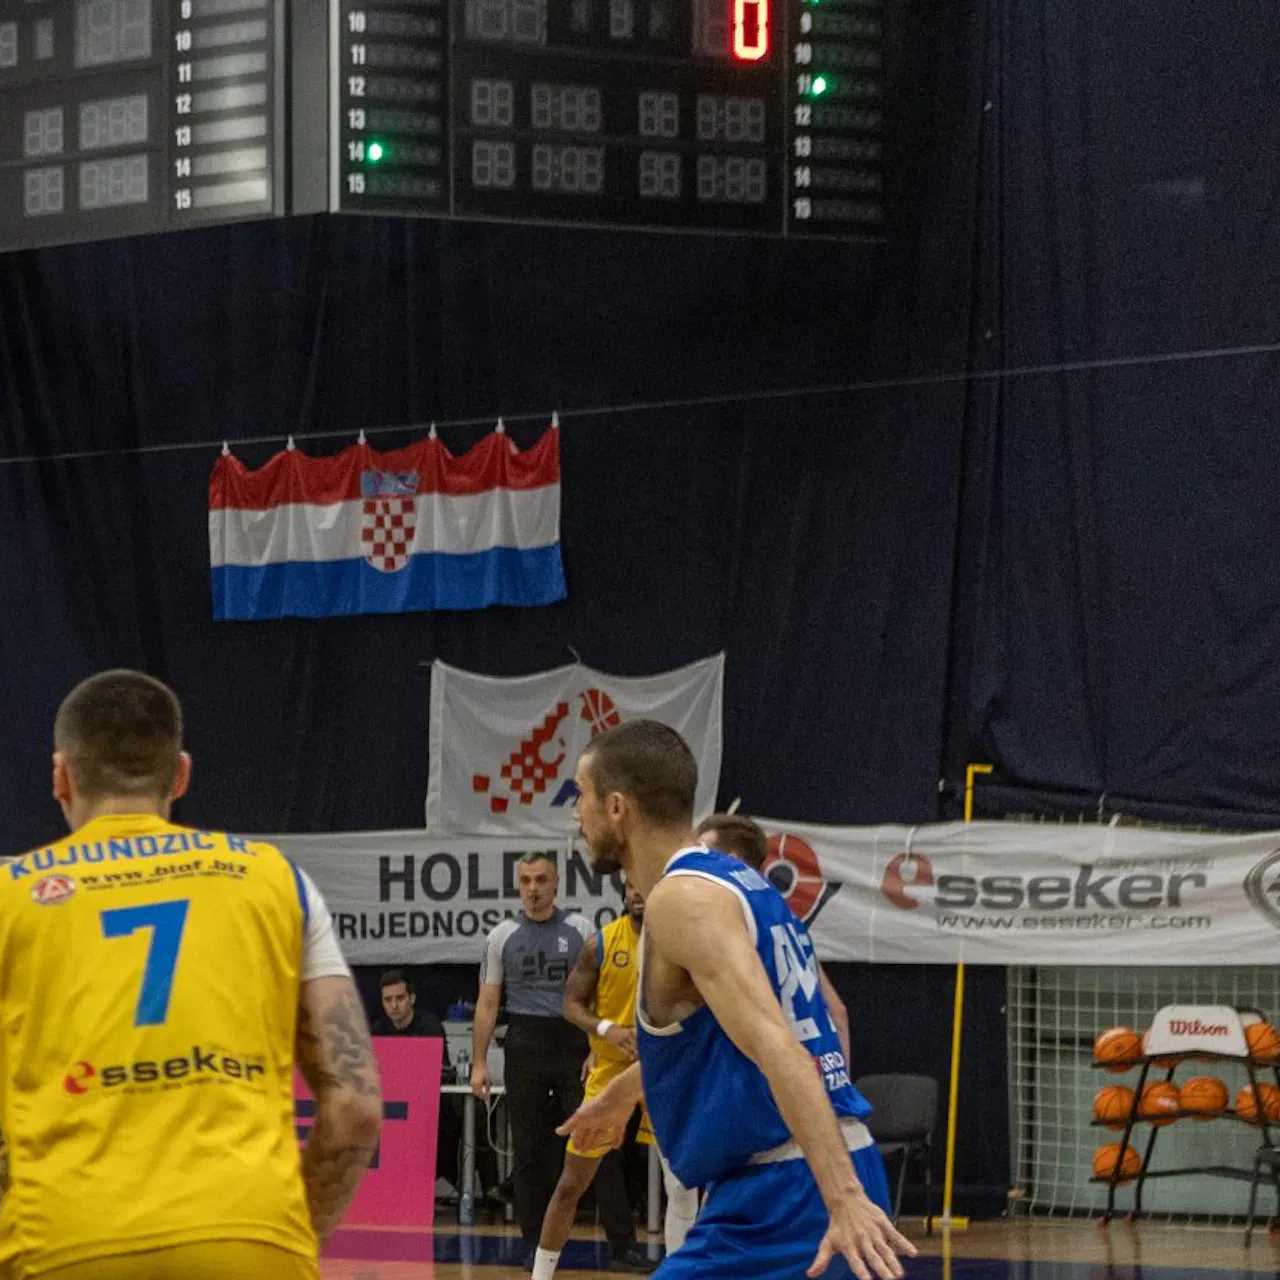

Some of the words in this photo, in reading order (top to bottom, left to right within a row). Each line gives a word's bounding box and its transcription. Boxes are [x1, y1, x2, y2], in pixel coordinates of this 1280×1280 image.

[348, 11, 366, 33] 10
[175, 30, 191, 51] 10
[350, 44, 366, 65] 11
[178, 62, 191, 83] 11
[348, 76, 365, 97] 12
[176, 93, 191, 114] 12
[348, 108, 366, 130] 13
[795, 104, 812, 126] 12
[175, 125, 191, 146] 13
[348, 141, 365, 162] 14
[175, 157, 191, 178] 14
[348, 173, 365, 194] 15
[175, 189, 191, 210] 15
[882, 852, 1207, 910] esseker
[937, 914, 1212, 931] www.esseker.com
[99, 898, 192, 1028] 7
[1169, 1020, 1229, 1036] Wilson
[64, 1046, 267, 1095] esseker
